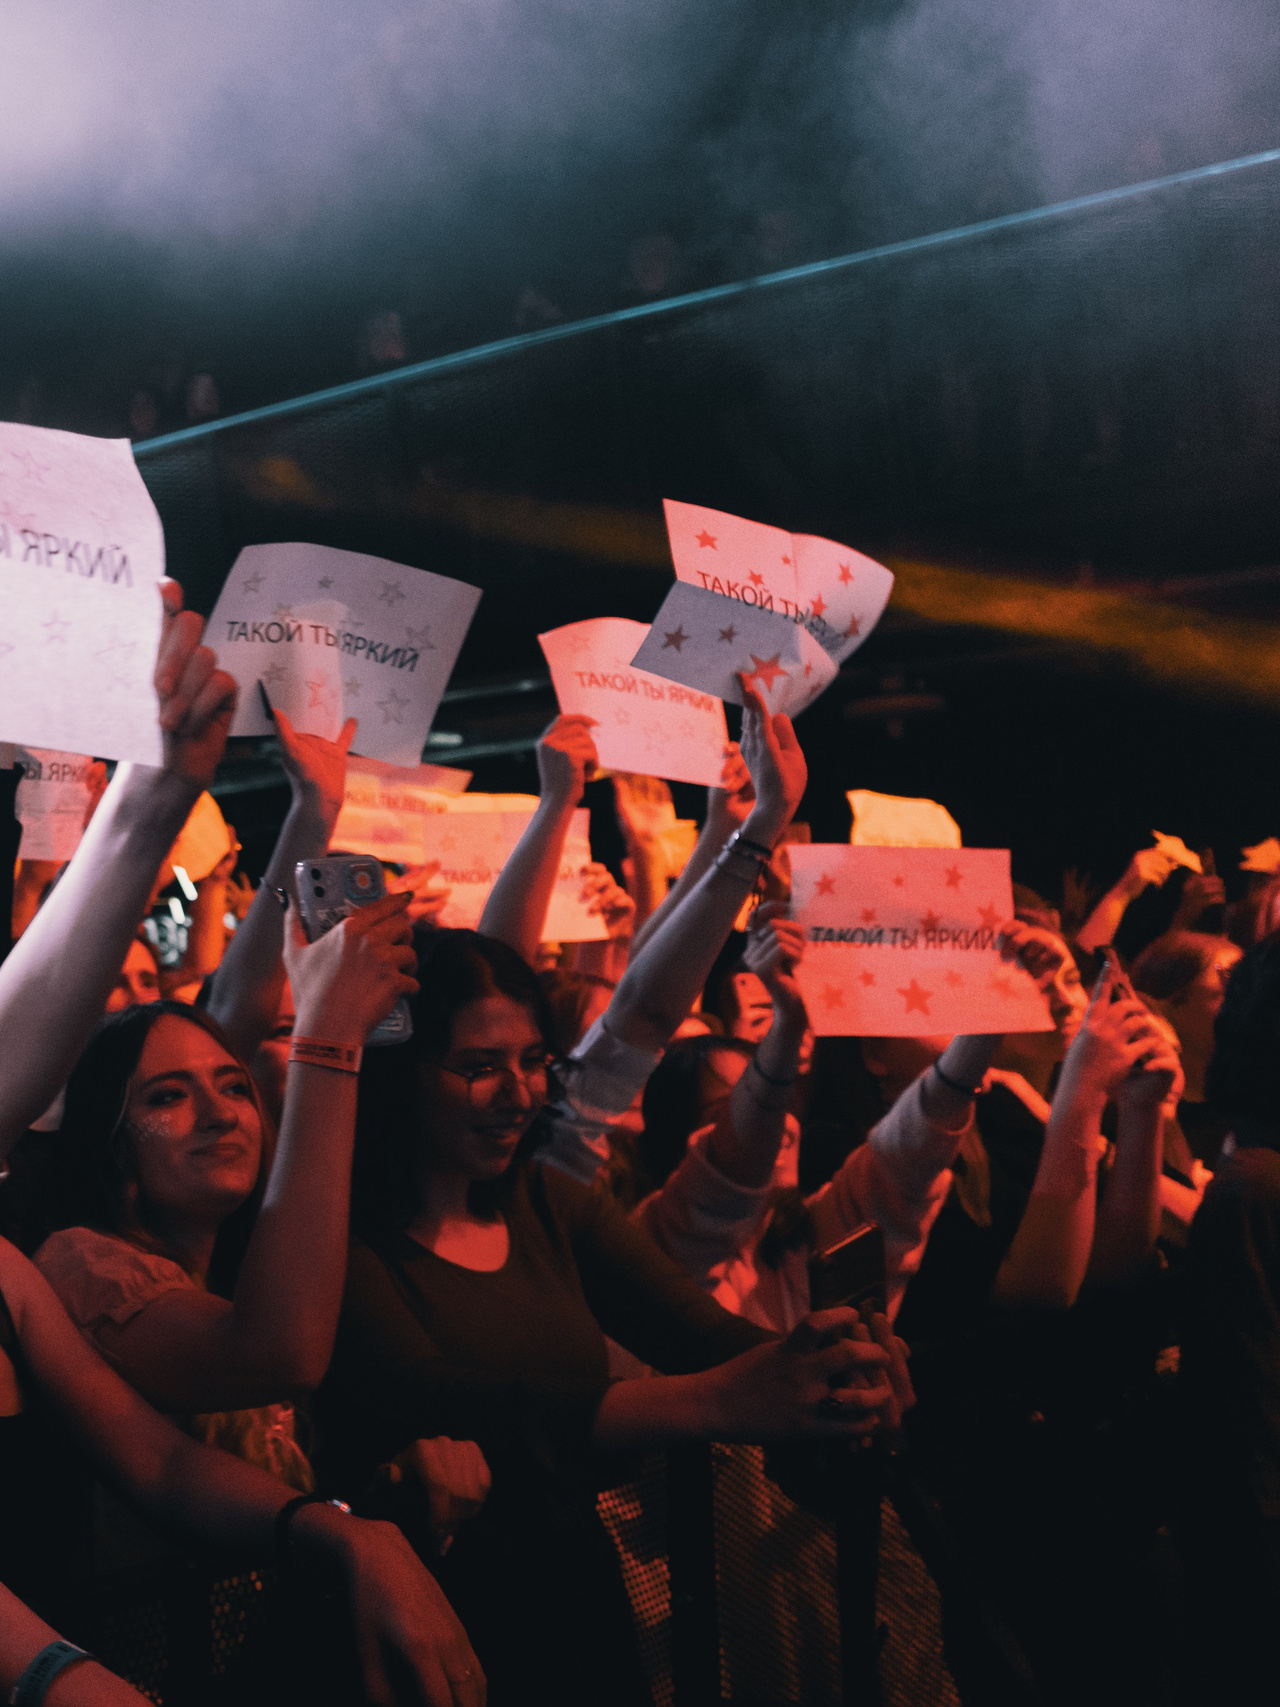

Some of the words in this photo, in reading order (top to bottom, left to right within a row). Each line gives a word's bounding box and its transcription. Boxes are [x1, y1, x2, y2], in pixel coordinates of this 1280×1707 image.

[20, 528, 134, 588] ЯРКИЙ
[696, 570, 774, 614] ТАКОЙ
[227, 619, 303, 644] ТАКОЙ
[341, 633, 419, 672] ЯРКИЙ
[574, 670, 638, 695] ТАКОЙ
[810, 924, 884, 946] ТАКОЙ
[890, 927, 919, 950] ТЫ
